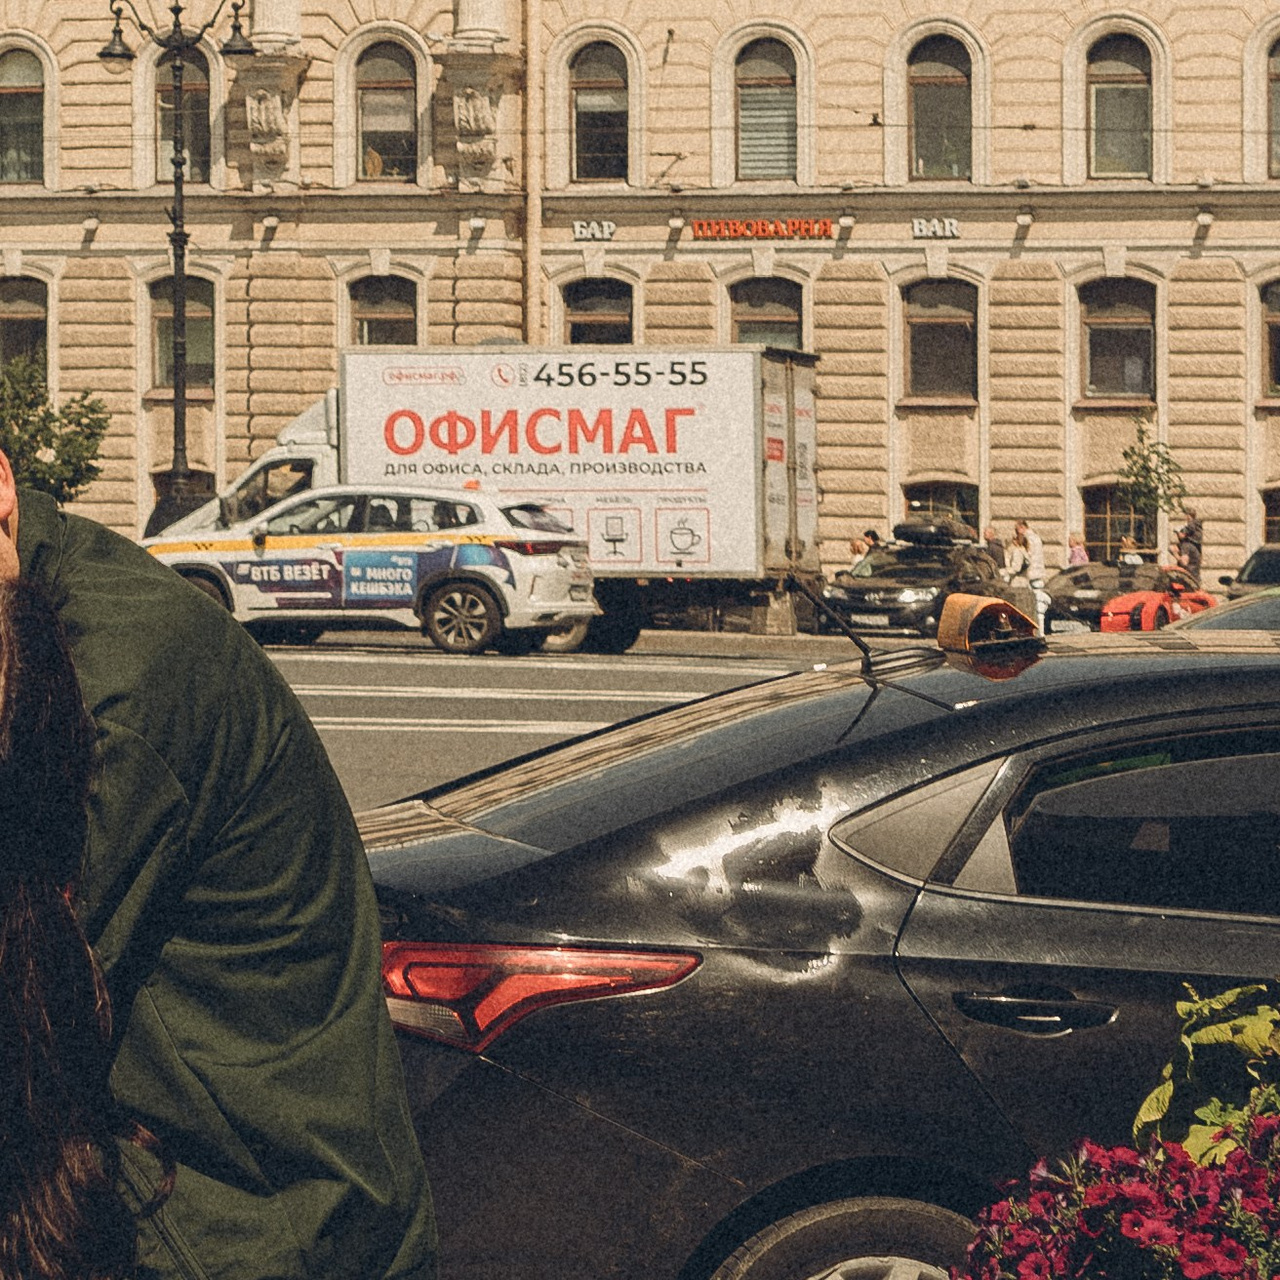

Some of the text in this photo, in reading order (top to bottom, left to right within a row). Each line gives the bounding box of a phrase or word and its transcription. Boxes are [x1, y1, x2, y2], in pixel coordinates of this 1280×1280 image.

[573, 220, 617, 240] БАР
[692, 218, 833, 238] ПИВОВАРНЯ
[912, 218, 960, 238] BAR
[533, 361, 708, 386] 456-55-55
[383, 407, 696, 456] ОФИСМАГ
[383, 462, 708, 477] ДЛЯ ОФИСА, СКЛАДА, ПРОИЗВОДСТВА
[251, 562, 331, 582] ВТБ ВЕЗЁТ
[366, 567, 413, 581] МНОГО
